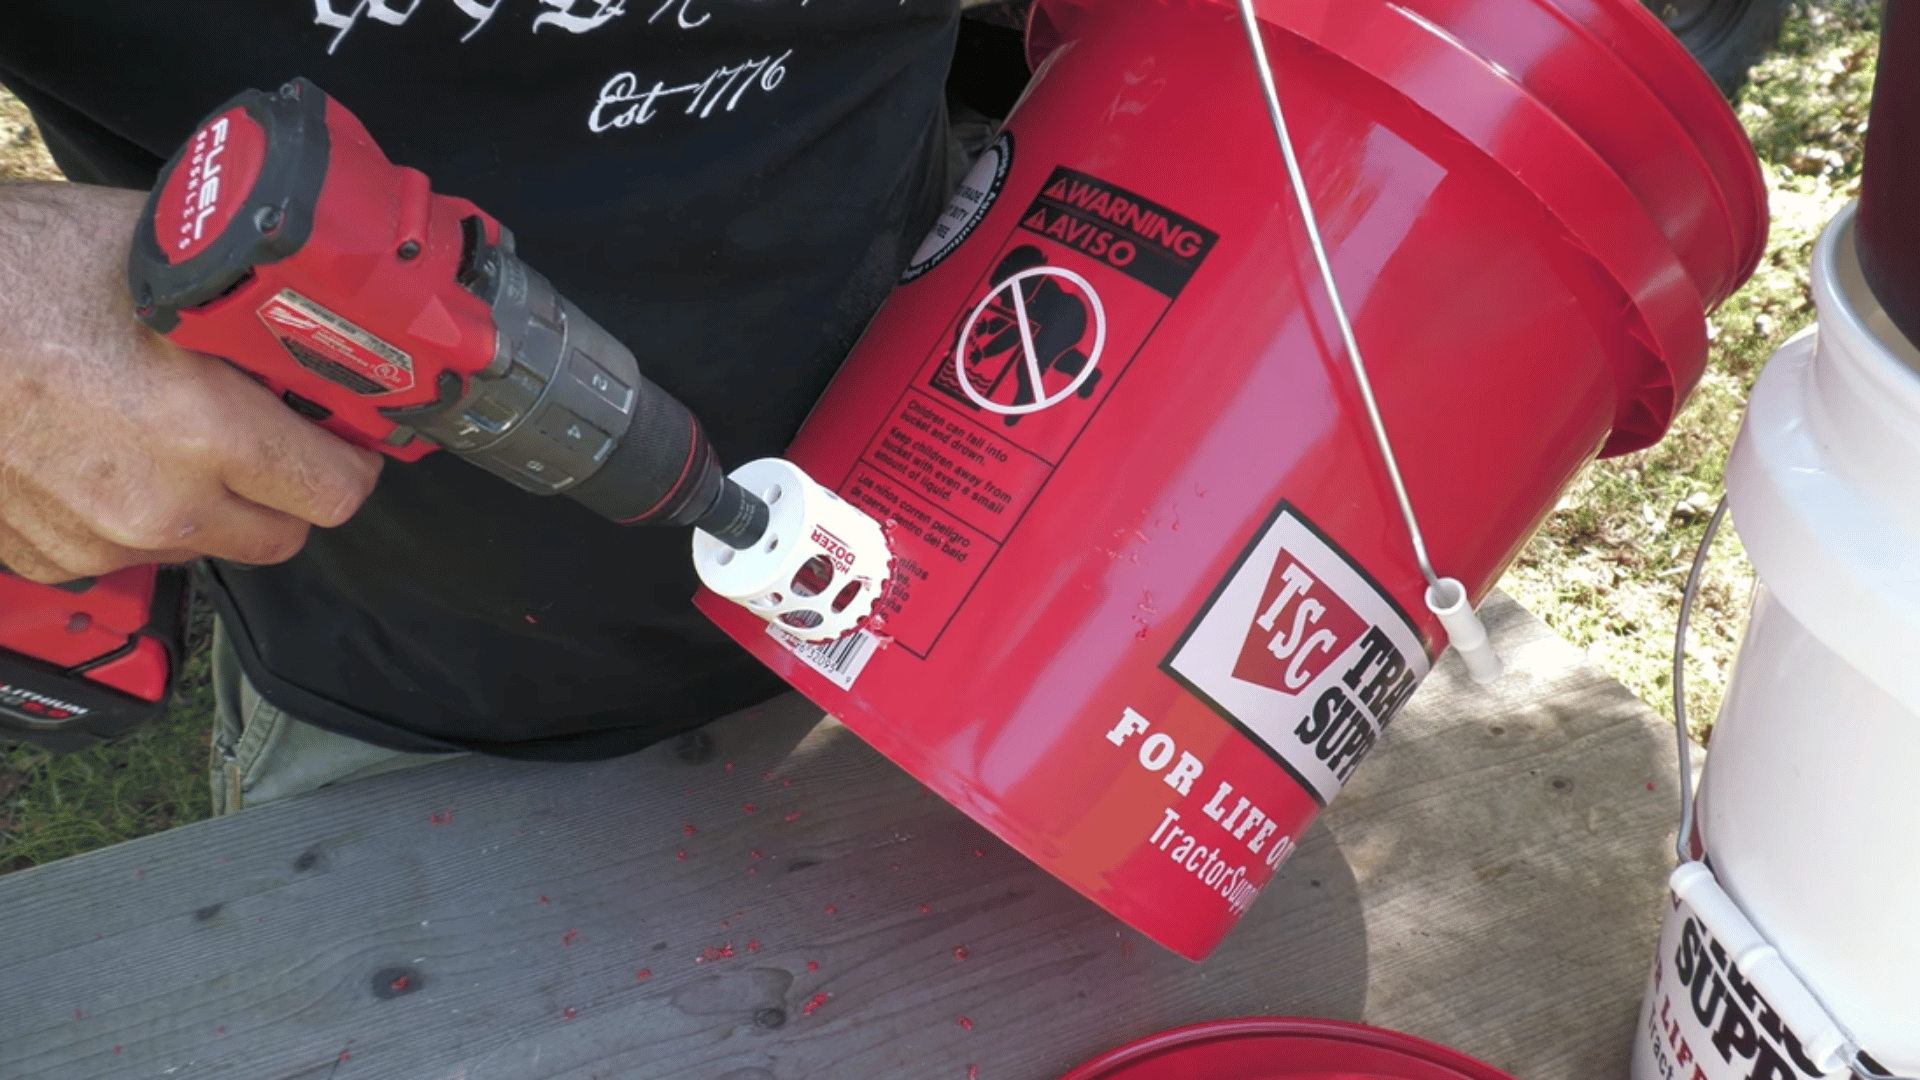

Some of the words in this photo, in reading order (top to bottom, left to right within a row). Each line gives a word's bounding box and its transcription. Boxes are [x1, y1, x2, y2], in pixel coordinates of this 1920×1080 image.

[589, 72, 692, 132] Est
[685, 49, 792, 118] 1776
[194, 117, 229, 240] FUEL
[1044, 214, 1137, 268] AVISO
[1066, 179, 1203, 259] WARNING
[591, 373, 608, 392] 2
[567, 424, 582, 440] 4
[873, 449, 909, 474] amount
[907, 469, 921, 481] of
[890, 426, 912, 445] Keep
[911, 441, 954, 470] children
[953, 465, 983, 488] away
[984, 480, 1012, 504] from
[900, 410, 931, 432] bucket
[930, 428, 952, 444] and
[950, 440, 986, 467] drown.
[907, 399, 946, 427] Children
[946, 422, 966, 437] can
[966, 432, 986, 449] fall
[985, 443, 1009, 463] into
[858, 472, 874, 489] Los
[873, 484, 899, 504] niños
[899, 500, 932, 524] corren
[931, 520, 971, 548] peligro
[881, 439, 913, 460] bucket
[912, 457, 935, 475] with
[934, 470, 961, 491] even
[961, 486, 971, 496] a
[970, 491, 1005, 515] small
[810, 529, 856, 566] DOZER
[850, 485, 862, 498] de
[861, 494, 891, 516] caerse
[891, 512, 923, 536] dentro
[923, 532, 941, 548] del
[1256, 562, 1338, 690] TSC
[1105, 706, 1204, 797] FOR
[1201, 780, 1279, 855] LIFE
